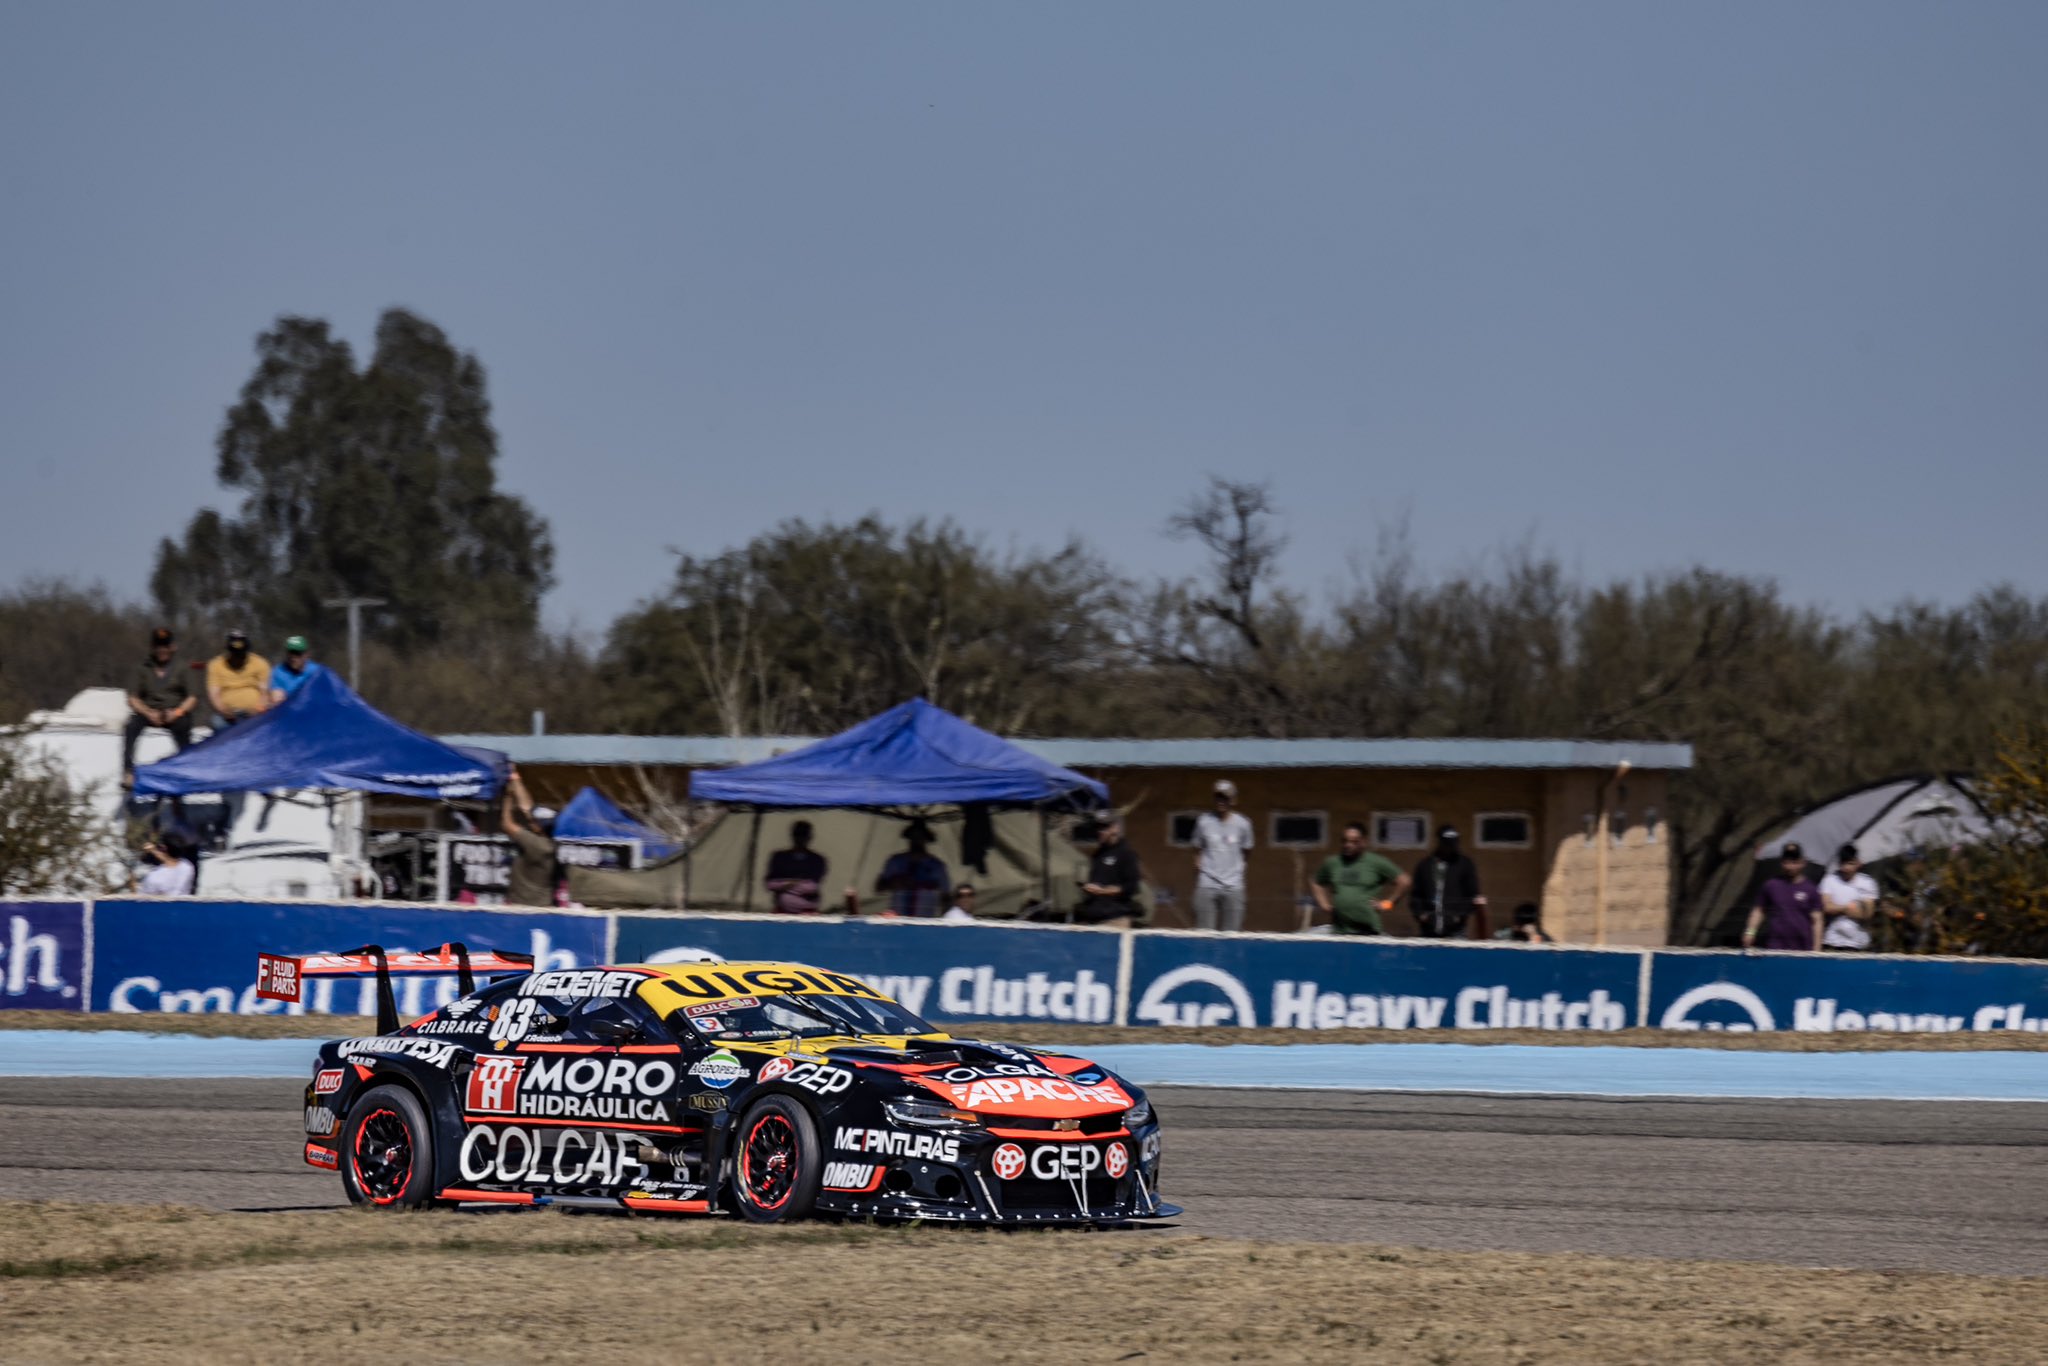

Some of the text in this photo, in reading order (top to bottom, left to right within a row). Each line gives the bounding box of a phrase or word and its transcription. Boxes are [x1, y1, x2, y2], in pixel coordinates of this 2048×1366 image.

[273, 960, 296, 978] FLUID
[272, 976, 296, 996] PARTS
[938, 965, 1112, 1024] Clutch
[488, 998, 537, 1042] 83
[691, 998, 754, 1015] DULCOR
[1455, 985, 1626, 1031] Clutch
[416, 1020, 489, 1034] CILBRAKE
[521, 1056, 676, 1097] MORO
[782, 1063, 854, 1095] GEP
[519, 1091, 671, 1122] HIDRÁULICA
[950, 1078, 1130, 1109] APACHE
[305, 1105, 336, 1134] OMBU
[822, 1161, 873, 1188] OMBU
[1030, 1143, 1100, 1181] GEP
